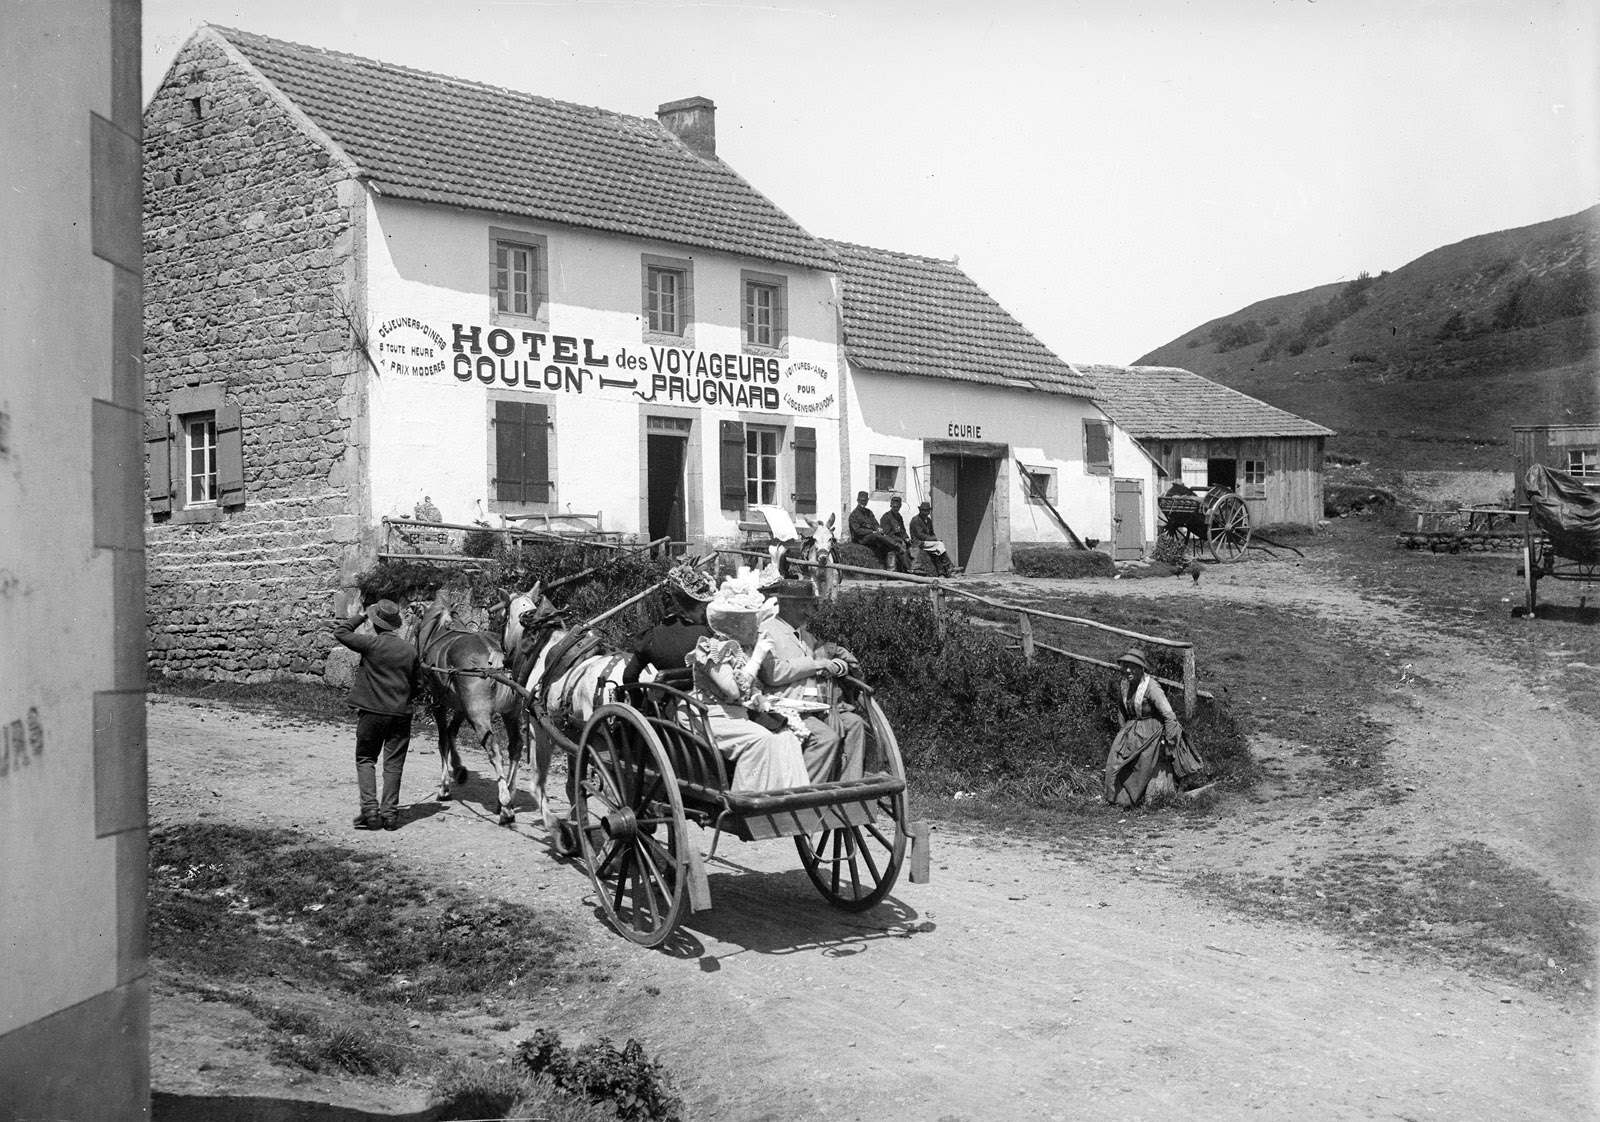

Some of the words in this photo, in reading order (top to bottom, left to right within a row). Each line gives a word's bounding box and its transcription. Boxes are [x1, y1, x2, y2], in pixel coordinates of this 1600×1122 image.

[386, 343, 406, 354] TOUTE
[411, 345, 434, 358] HEURE
[452, 323, 609, 367] HOTEL
[615, 348, 648, 371] des
[650, 346, 780, 385] VOYAGEURS
[391, 361, 409, 376] PRIX
[453, 353, 593, 394] COULON
[633, 373, 780, 410] PRUGNARD
[797, 385, 816, 394] POUR
[948, 420, 982, 439] ÉCURIE
